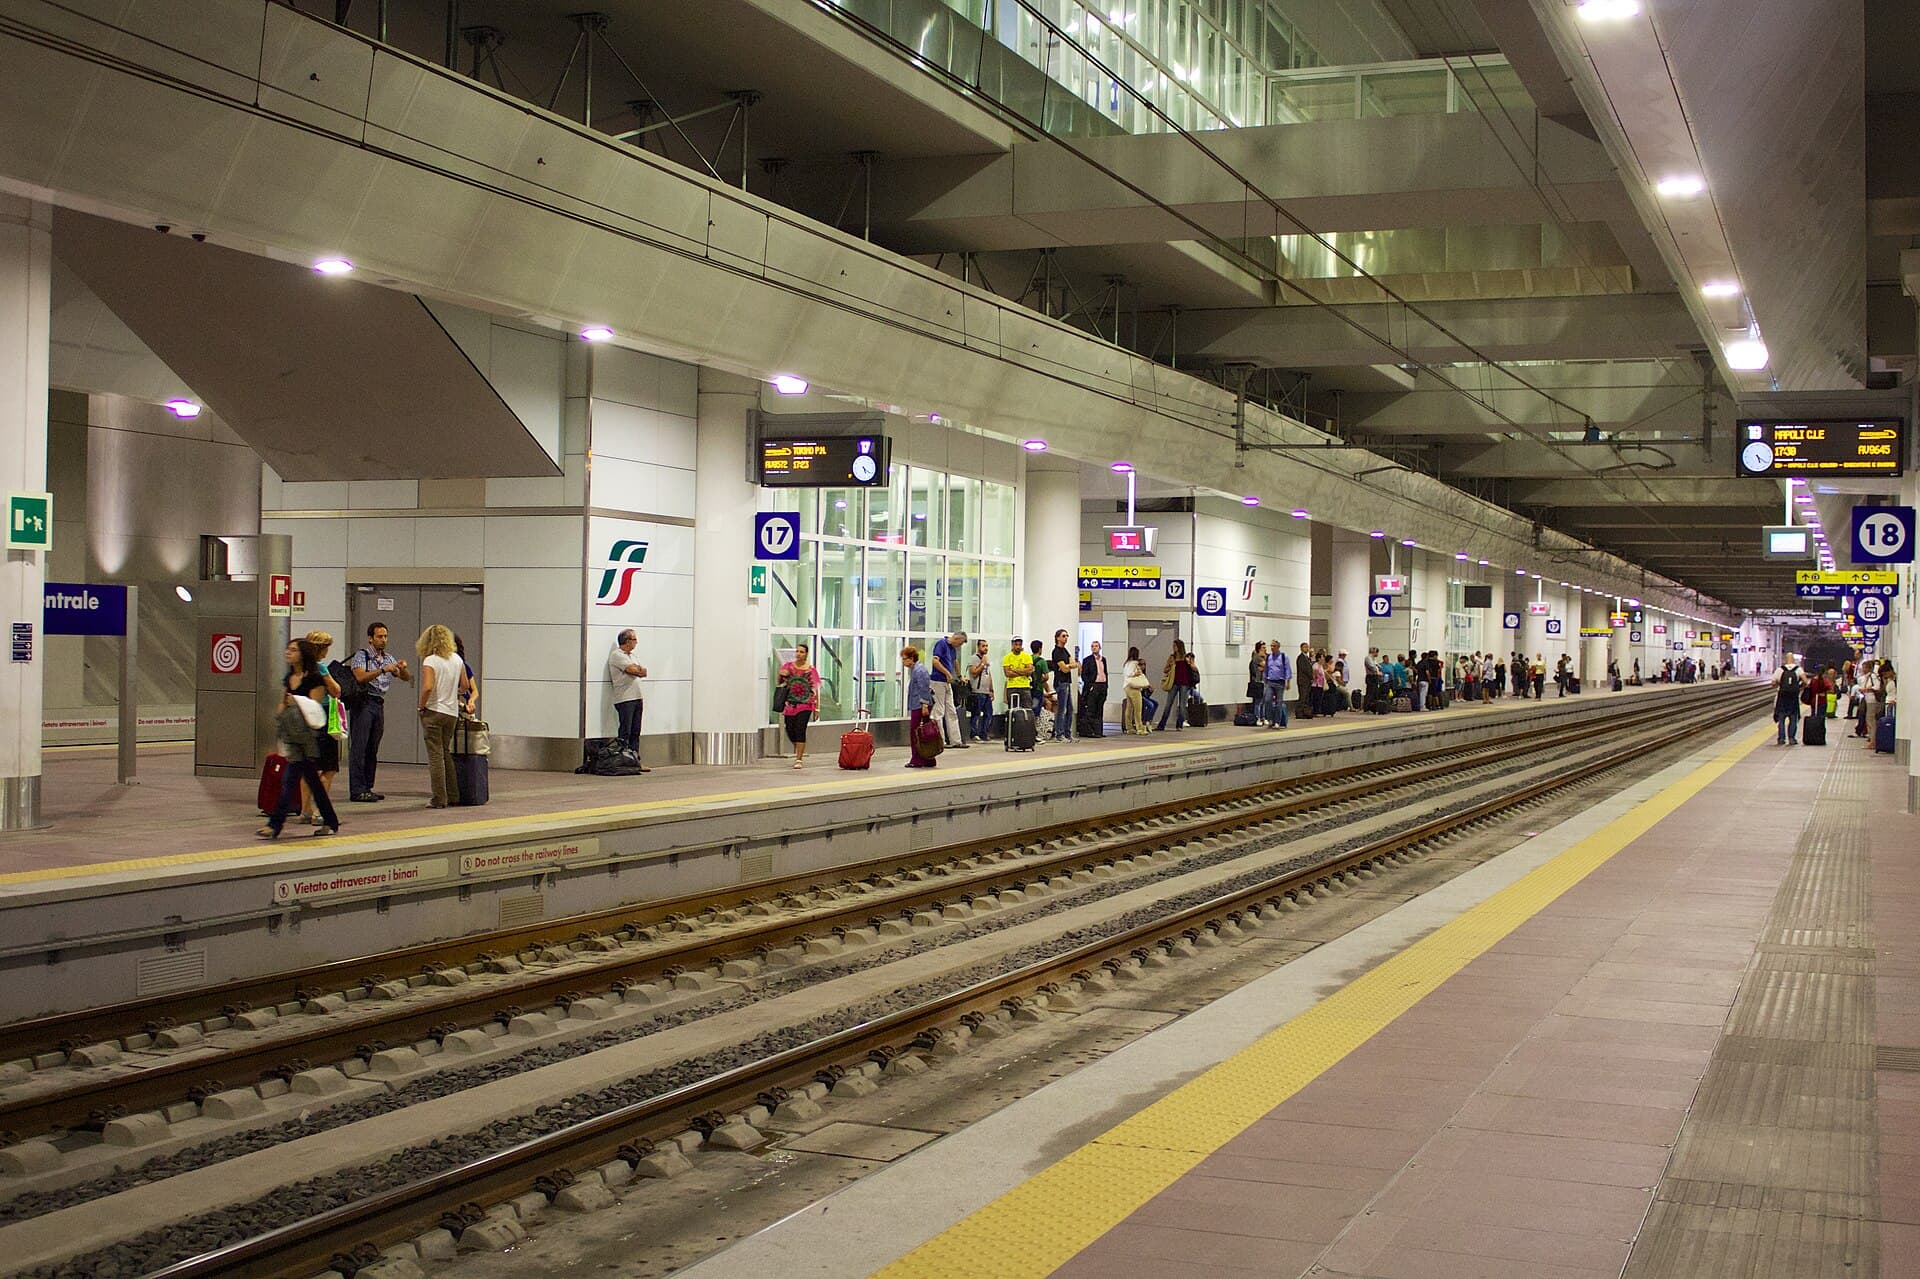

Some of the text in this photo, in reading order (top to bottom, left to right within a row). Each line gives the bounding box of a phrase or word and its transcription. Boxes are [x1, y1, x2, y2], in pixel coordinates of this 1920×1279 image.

[1775, 430, 1805, 440] NAPOLI
[765, 526, 790, 545] 17
[1865, 523, 1899, 546] 18
[1170, 585, 1181, 594] 17
[43, 590, 100, 610] ntrale
[1374, 601, 1387, 611] 17
[475, 846, 578, 868] Do not cross the railway lines
[293, 881, 328, 895] Vietato
[330, 874, 386, 890] attraversare
[393, 866, 418, 880] binari
